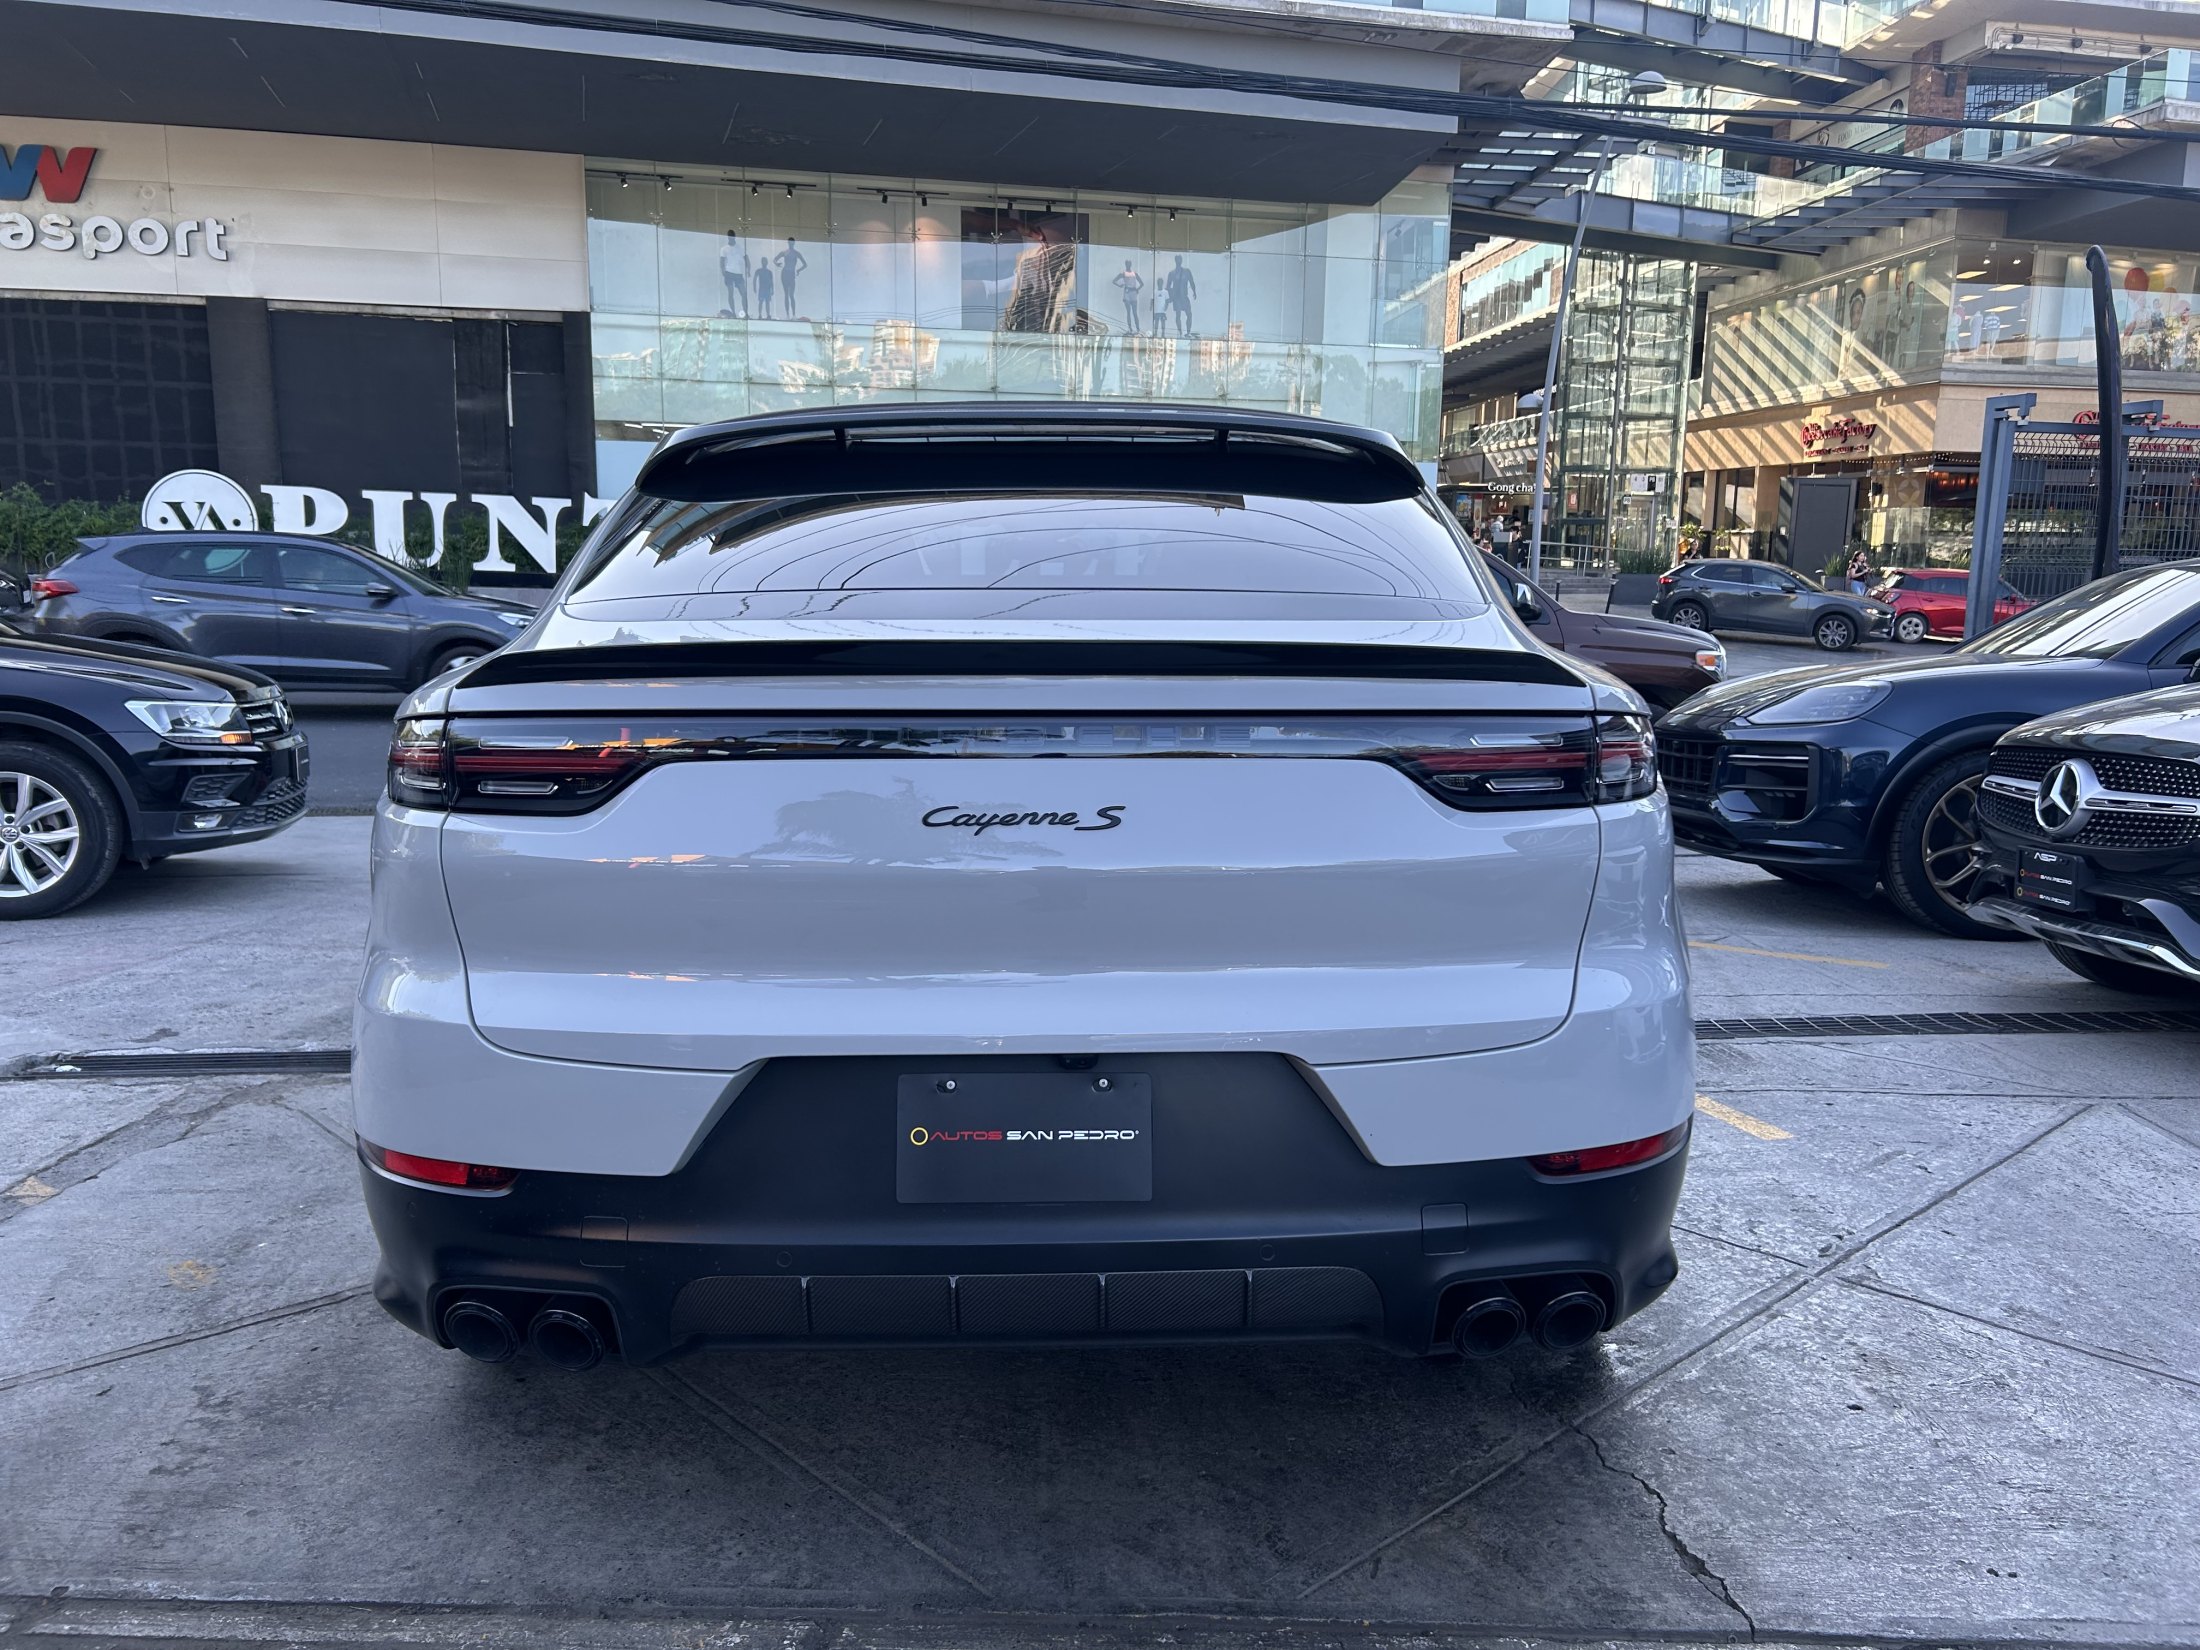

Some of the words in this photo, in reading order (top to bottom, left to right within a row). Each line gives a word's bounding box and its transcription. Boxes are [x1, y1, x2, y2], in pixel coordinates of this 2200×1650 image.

[1488, 482, 1514, 494] Gong
[922, 806, 1080, 836] Cayenne
[1074, 806, 1126, 831] S
[930, 1130, 1003, 1141] AUTOS
[1006, 1130, 1053, 1141] SAN
[1058, 1130, 1135, 1141] PEDRO
